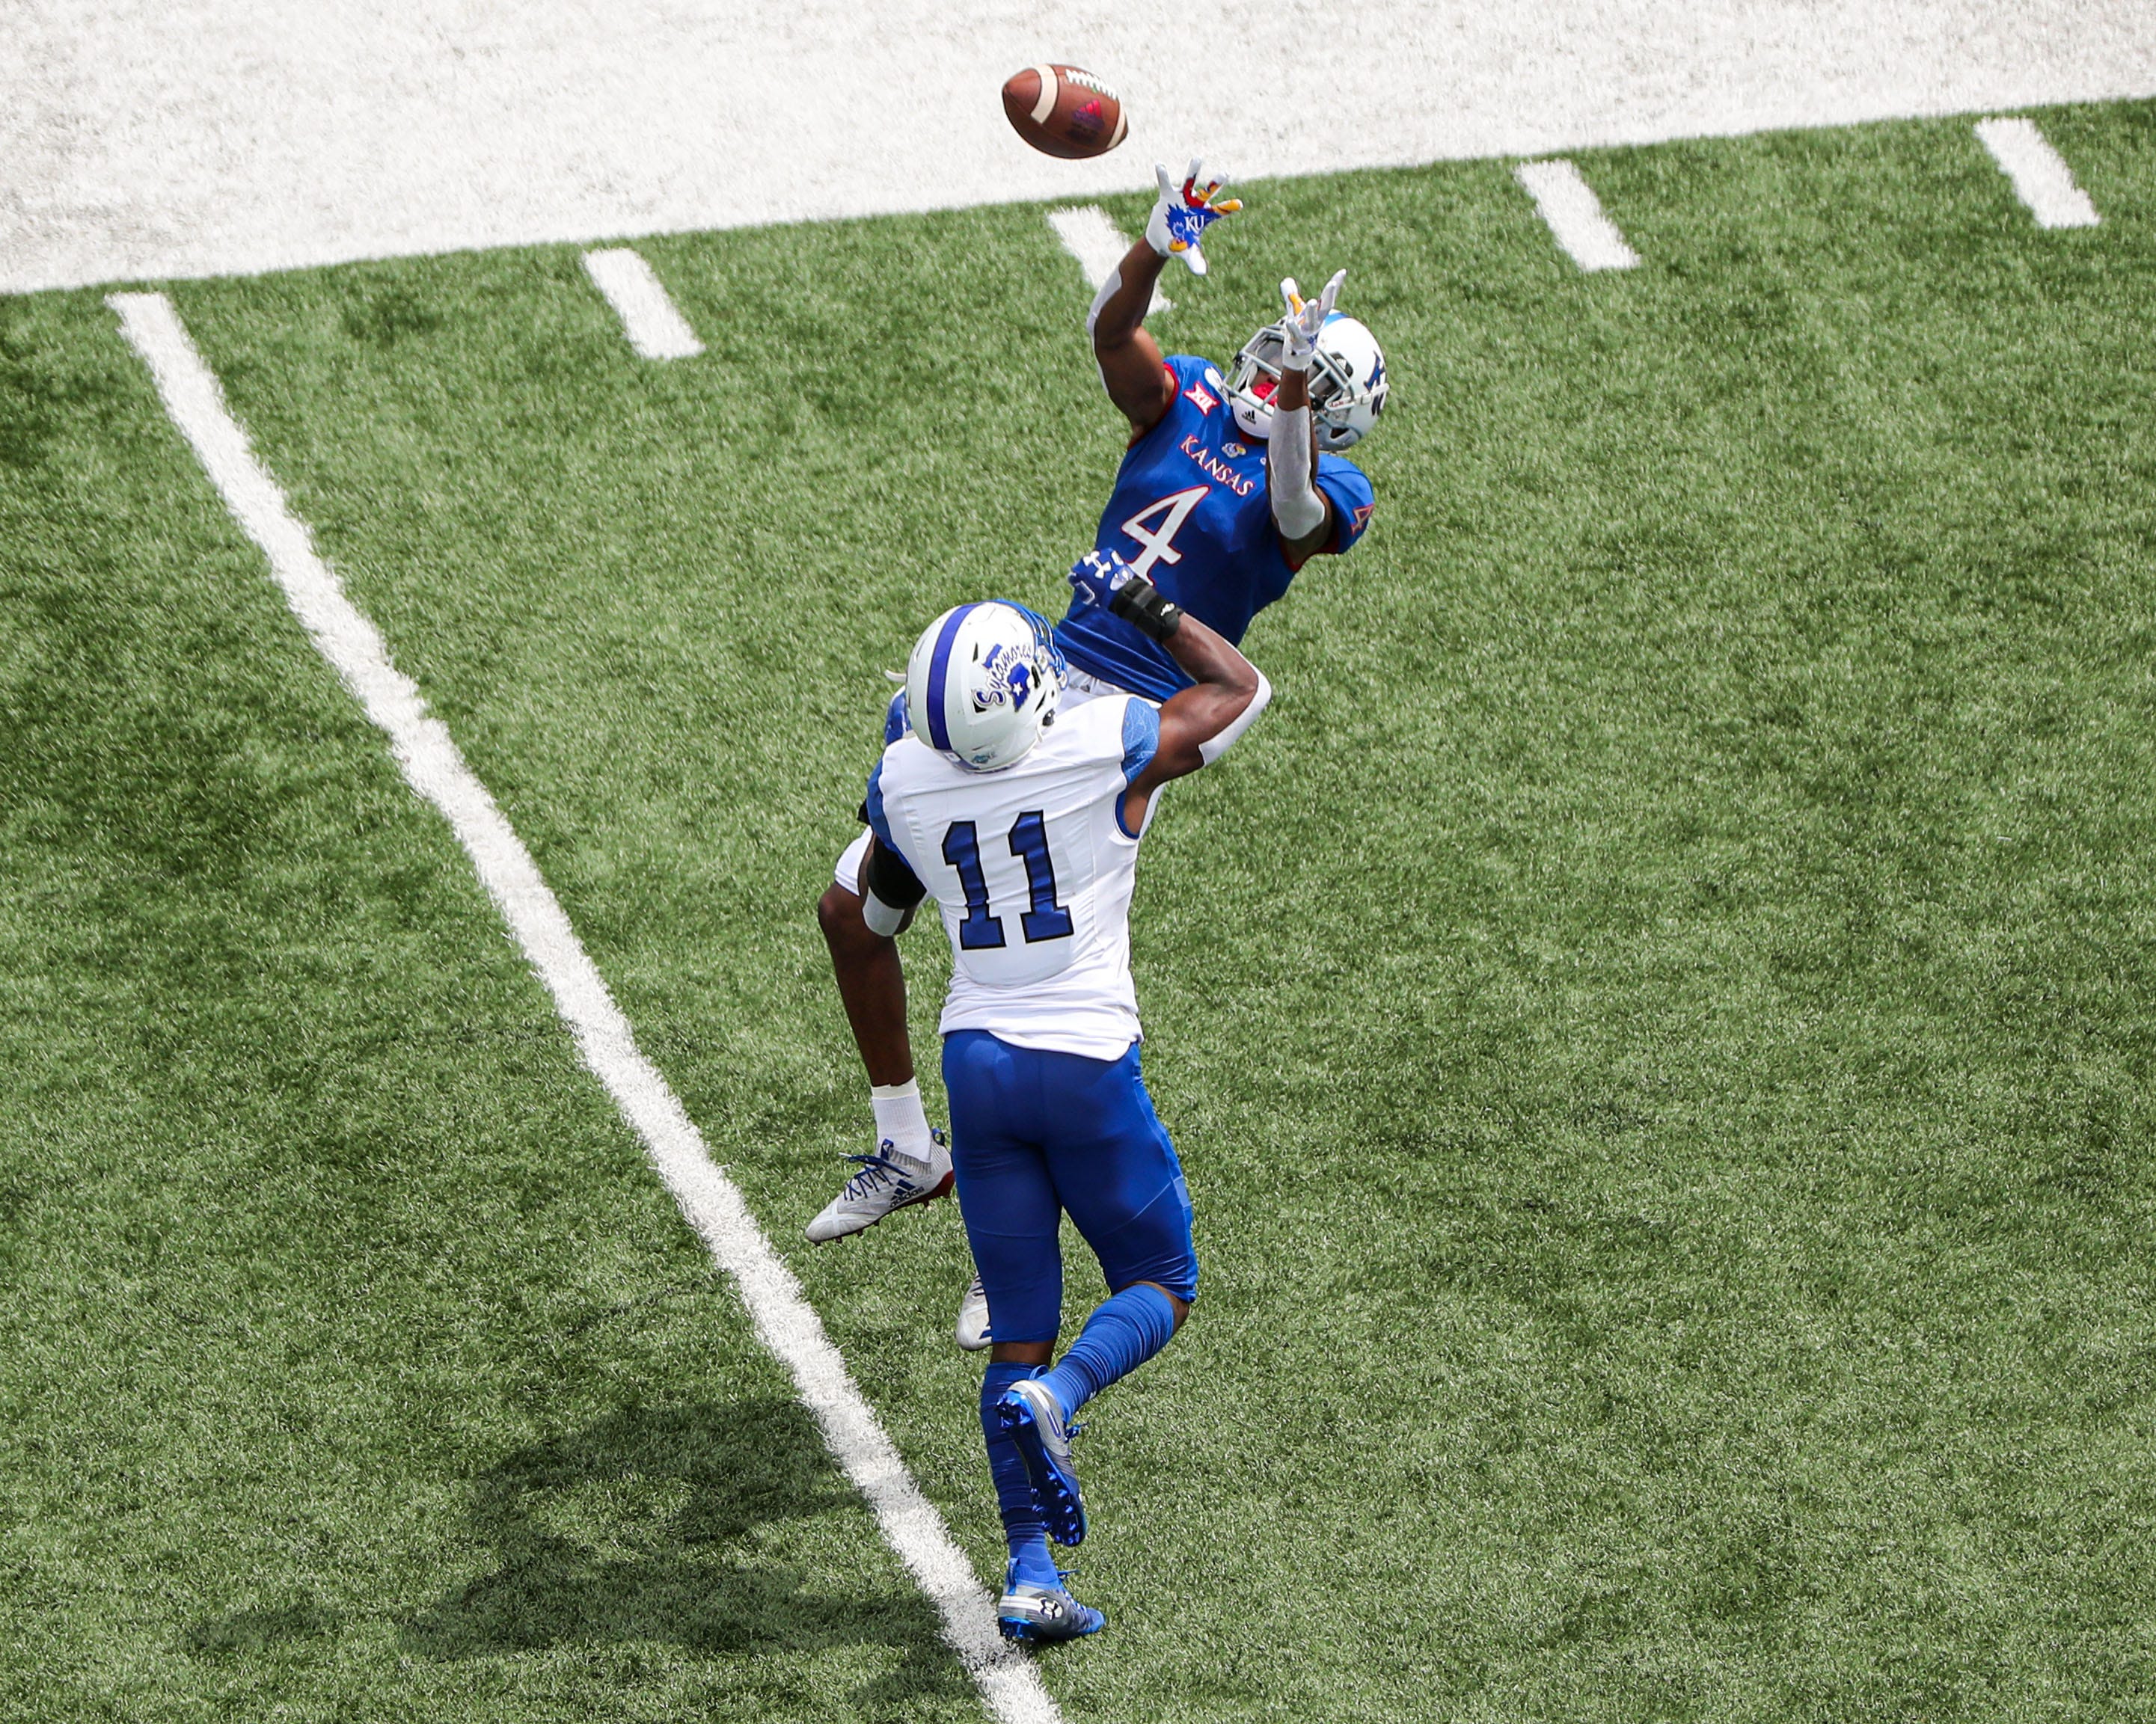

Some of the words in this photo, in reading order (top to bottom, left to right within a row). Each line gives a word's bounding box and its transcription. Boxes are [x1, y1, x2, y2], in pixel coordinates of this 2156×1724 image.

[1183, 214, 1204, 235] KU
[1179, 434, 1254, 495] KANSAS
[1121, 484, 1211, 586] 4
[1350, 503, 1374, 535] 4
[942, 809, 1074, 949] 11
